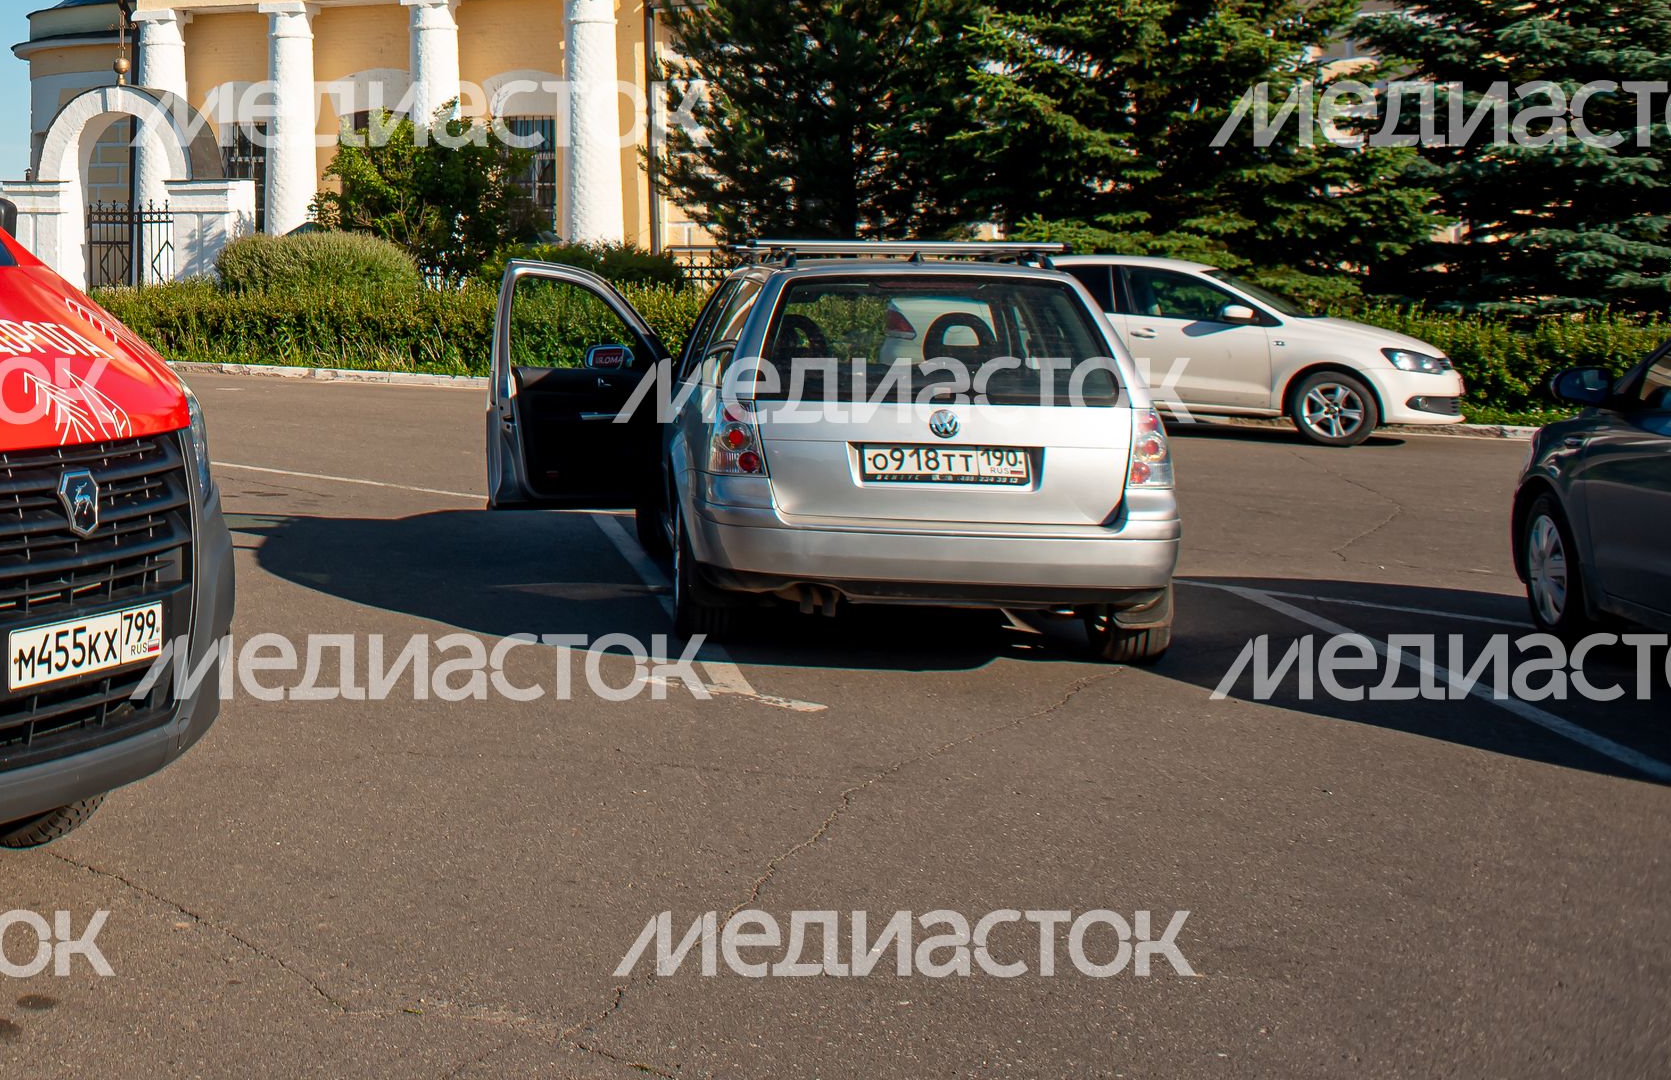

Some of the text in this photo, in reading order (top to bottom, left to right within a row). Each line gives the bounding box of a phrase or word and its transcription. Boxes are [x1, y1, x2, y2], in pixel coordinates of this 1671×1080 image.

[980, 448, 1018, 467] 190
[18, 609, 156, 681] М455КХ 799
[130, 642, 147, 655] RUS
